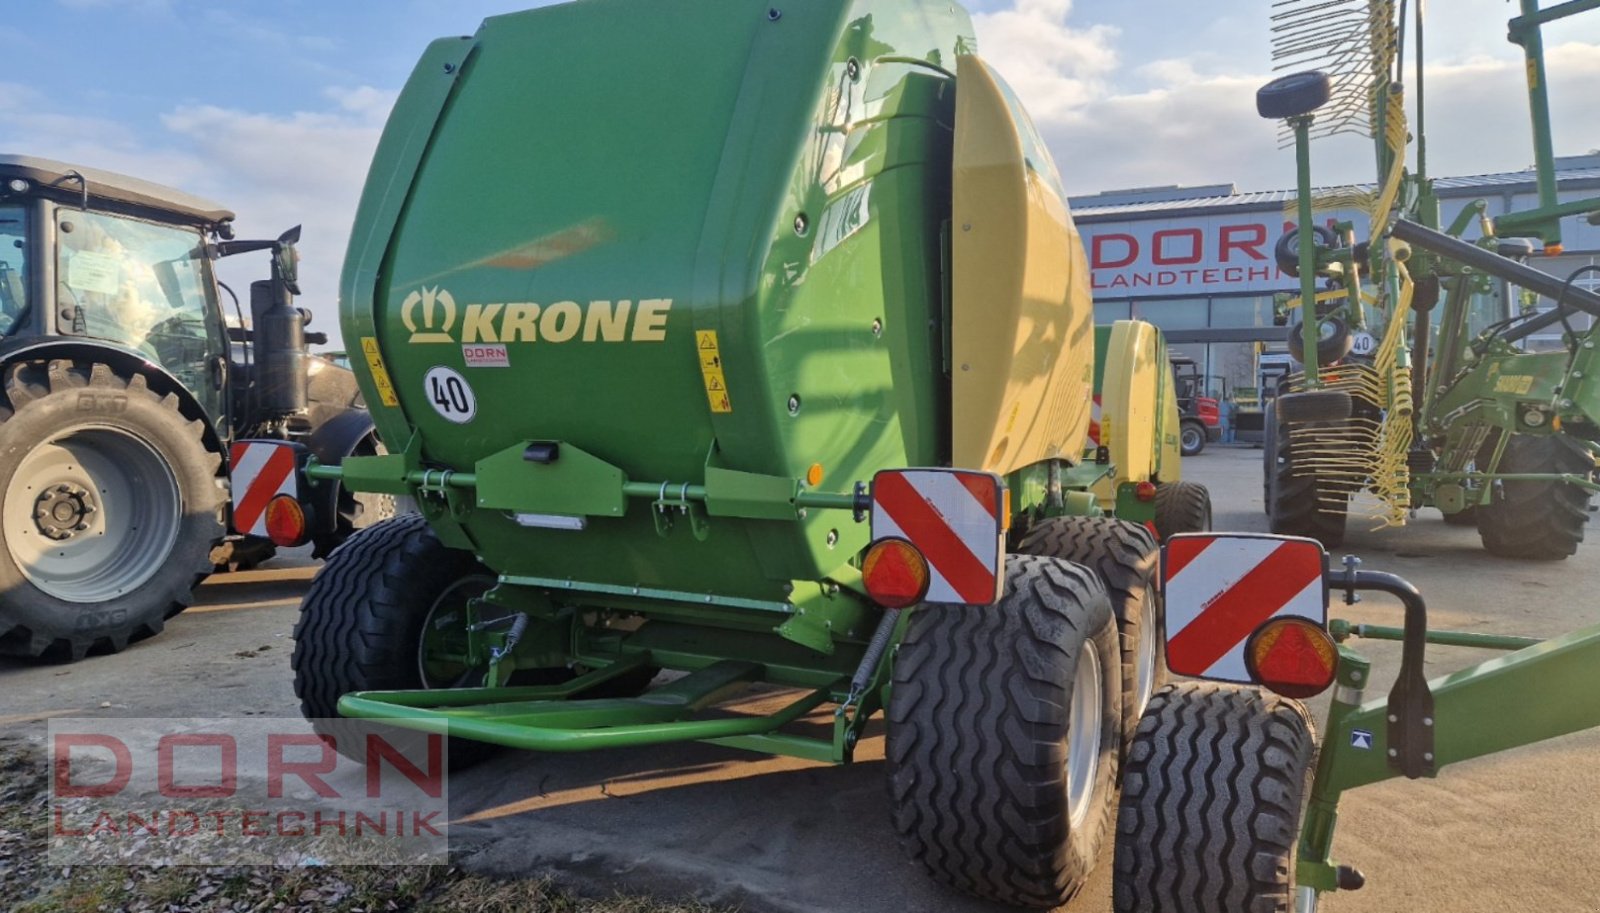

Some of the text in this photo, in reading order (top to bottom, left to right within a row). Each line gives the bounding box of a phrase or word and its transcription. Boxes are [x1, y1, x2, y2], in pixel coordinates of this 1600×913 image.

[1091, 218, 1338, 269] DOR
[1090, 264, 1283, 289] LANDTECH
[461, 298, 673, 343] KRONE
[464, 348, 505, 358] DORN
[1354, 336, 1369, 351] 40
[431, 376, 469, 413] 40
